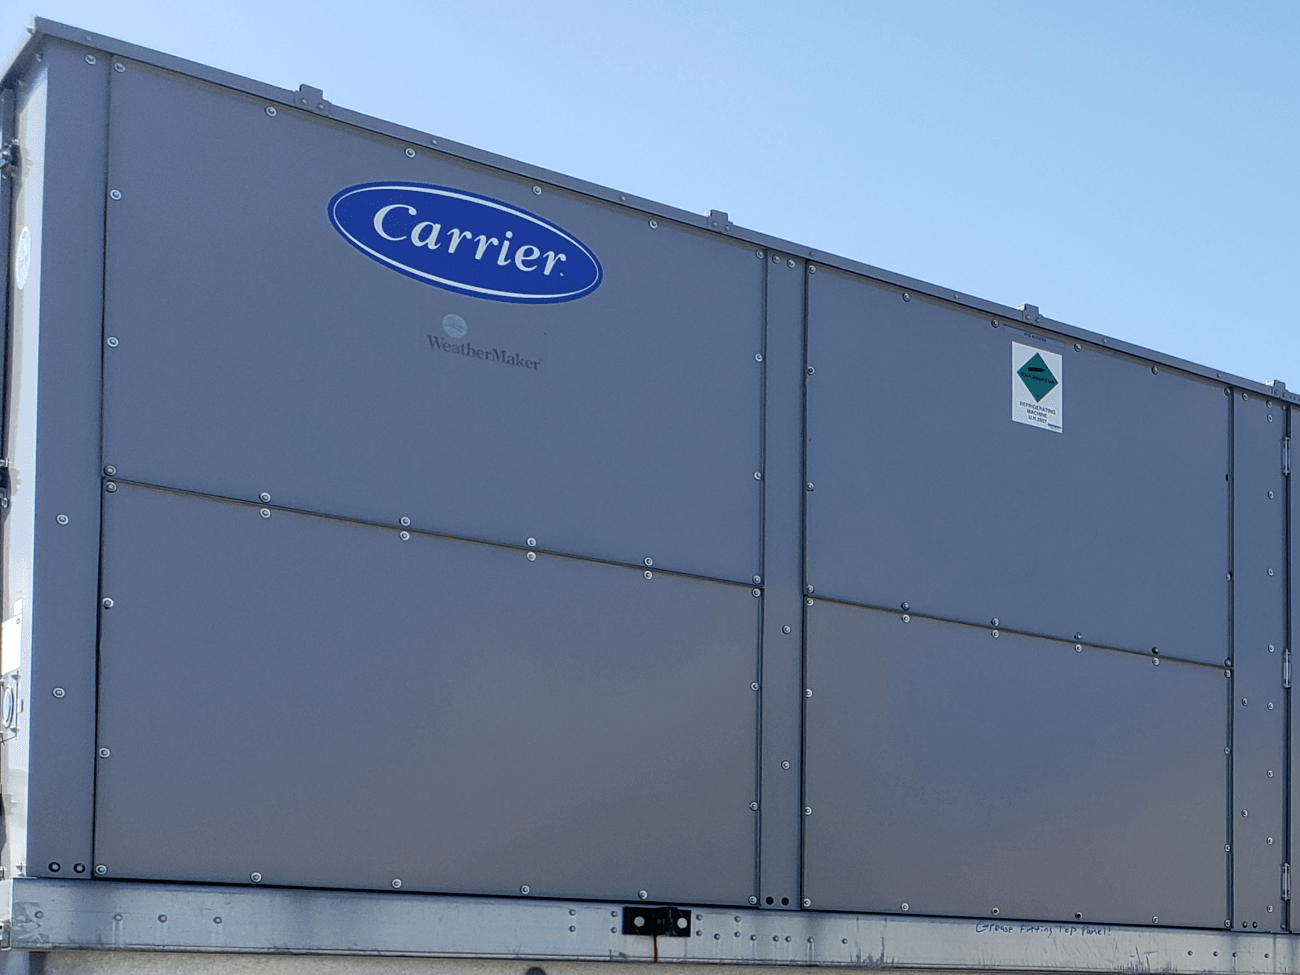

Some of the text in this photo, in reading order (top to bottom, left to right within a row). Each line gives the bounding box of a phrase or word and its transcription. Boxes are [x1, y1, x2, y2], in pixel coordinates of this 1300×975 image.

[373, 204, 567, 276] Carrier
[426, 334, 542, 371] WeatherMaker
[975, 920, 1013, 933] Grease
[1057, 925, 1077, 936] Top
